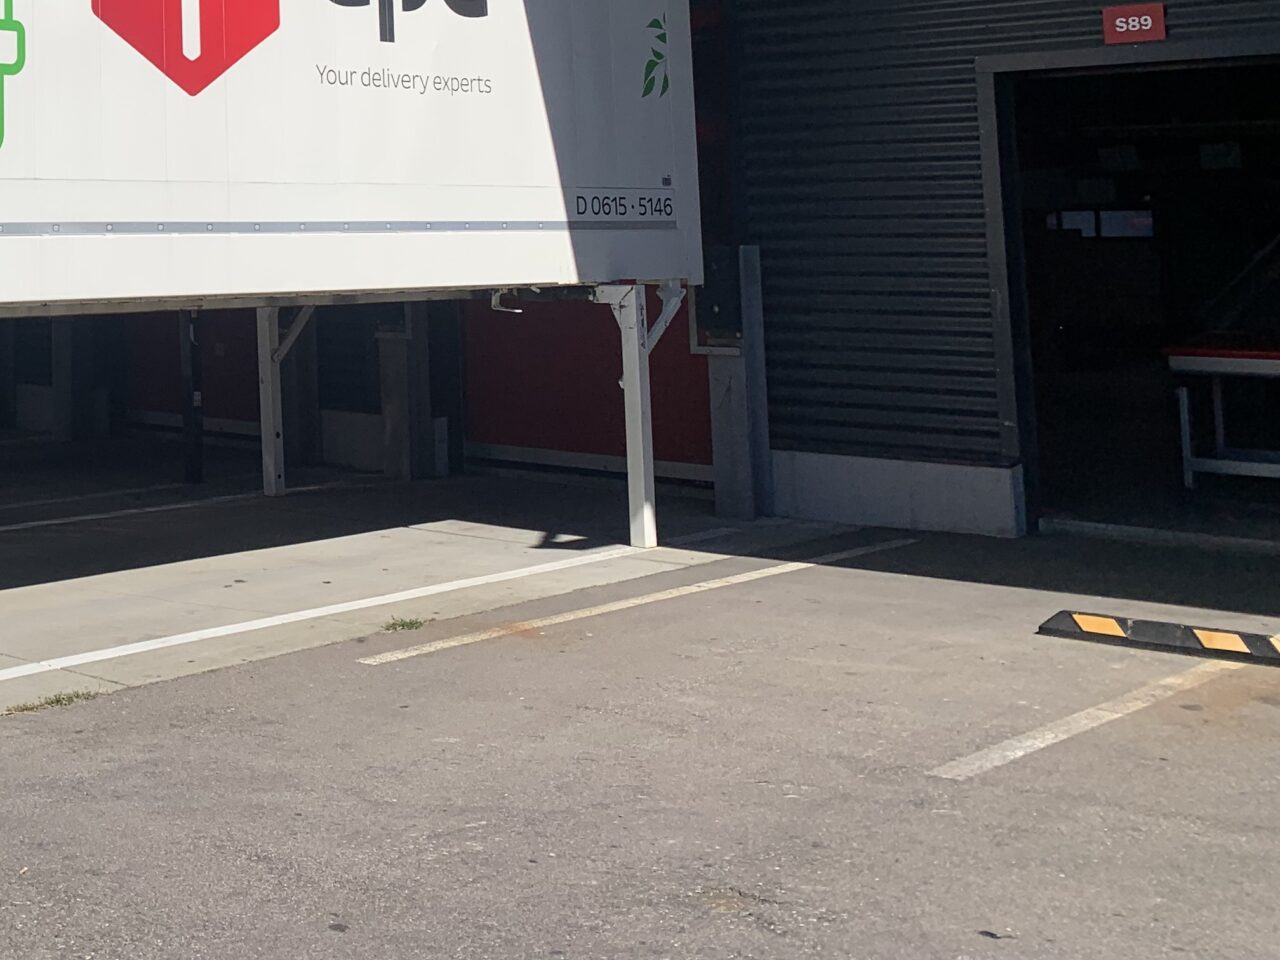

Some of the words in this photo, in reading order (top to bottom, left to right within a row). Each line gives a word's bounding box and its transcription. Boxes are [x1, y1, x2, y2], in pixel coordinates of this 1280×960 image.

[1115, 15, 1153, 32] S89
[315, 64, 357, 86] Your
[360, 66, 429, 95] delivery
[432, 74, 492, 96] experts
[576, 196, 587, 215] D
